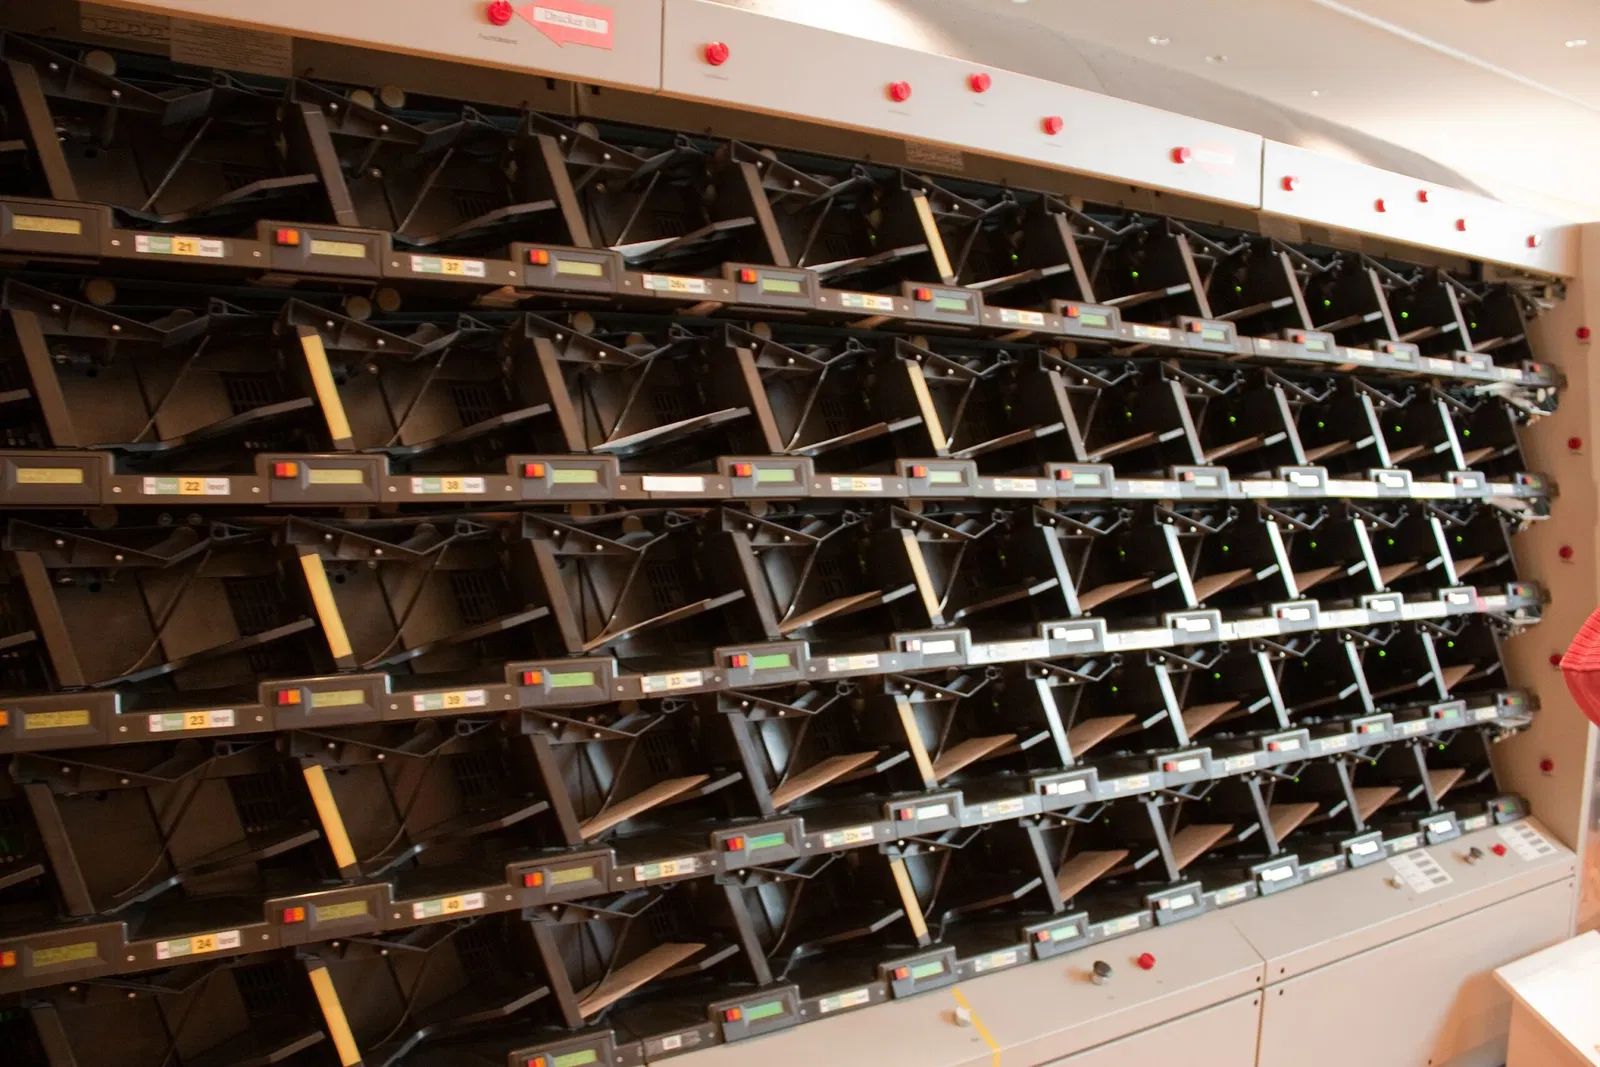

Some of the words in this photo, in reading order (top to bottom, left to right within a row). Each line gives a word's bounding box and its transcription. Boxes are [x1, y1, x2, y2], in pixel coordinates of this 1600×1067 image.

[177, 242, 192, 252] 21
[447, 262, 459, 271] 37
[184, 481, 200, 491] 22
[446, 481, 458, 490] 38
[448, 695, 461, 705] 39
[189, 715, 204, 726] 23
[447, 900, 460, 909] 40
[195, 938, 212, 950] 24
